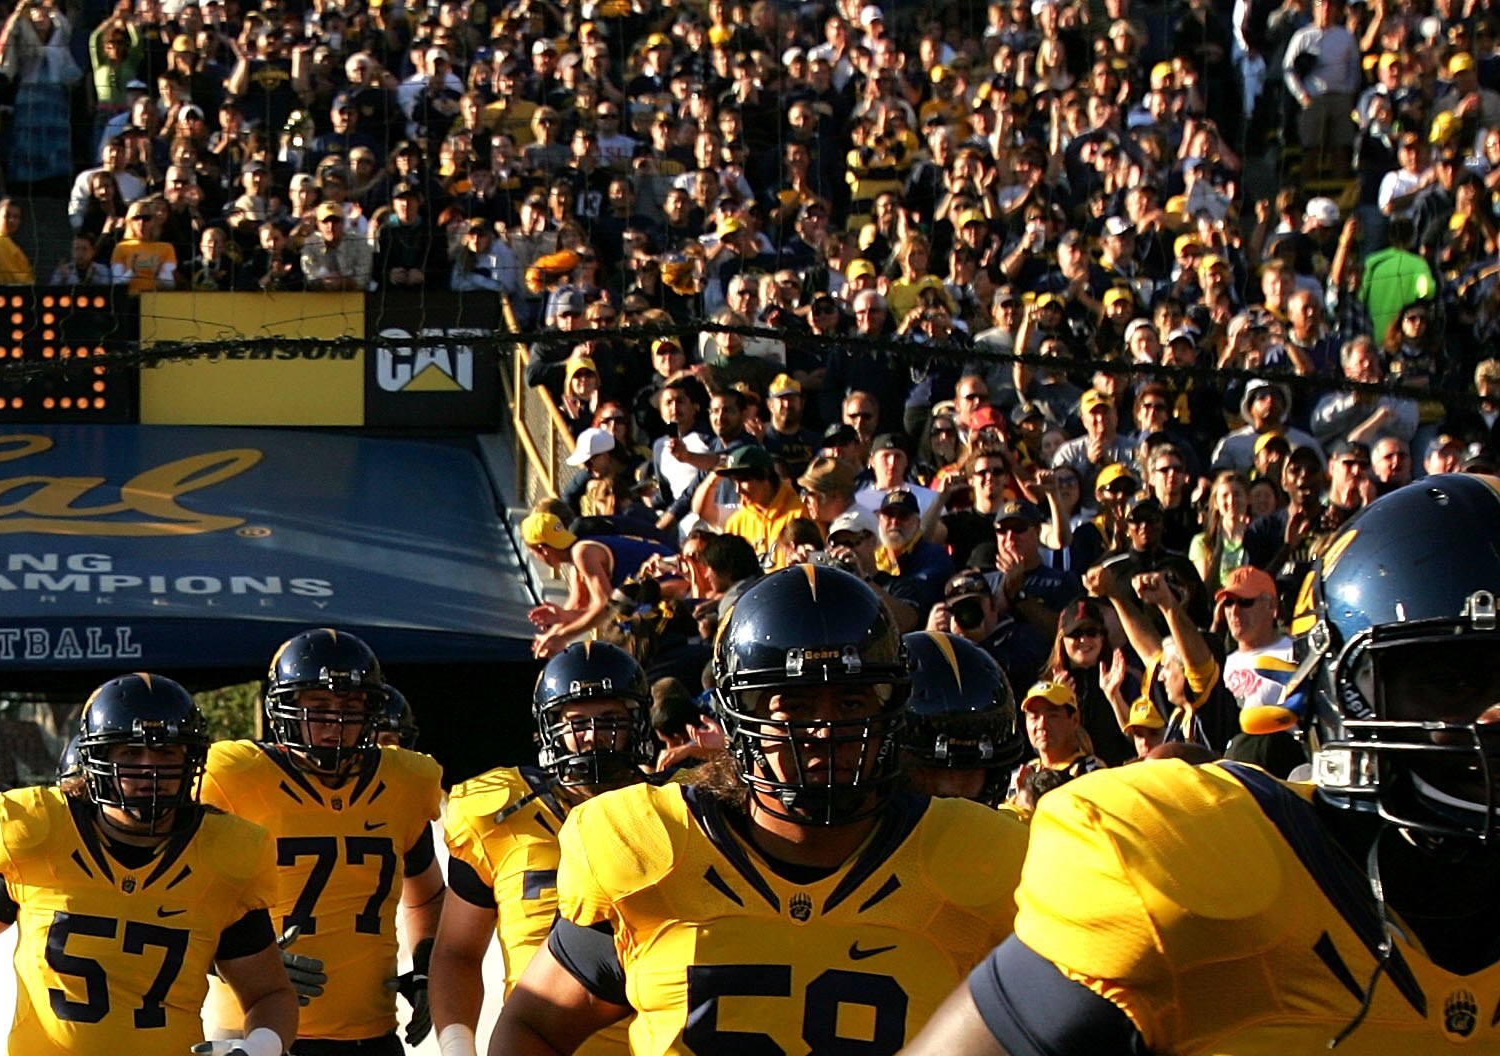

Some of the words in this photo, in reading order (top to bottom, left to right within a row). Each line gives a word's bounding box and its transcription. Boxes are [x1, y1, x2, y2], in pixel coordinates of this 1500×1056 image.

[804, 649, 840, 660] Bears
[277, 836, 397, 935] 77
[44, 911, 189, 1029] 57
